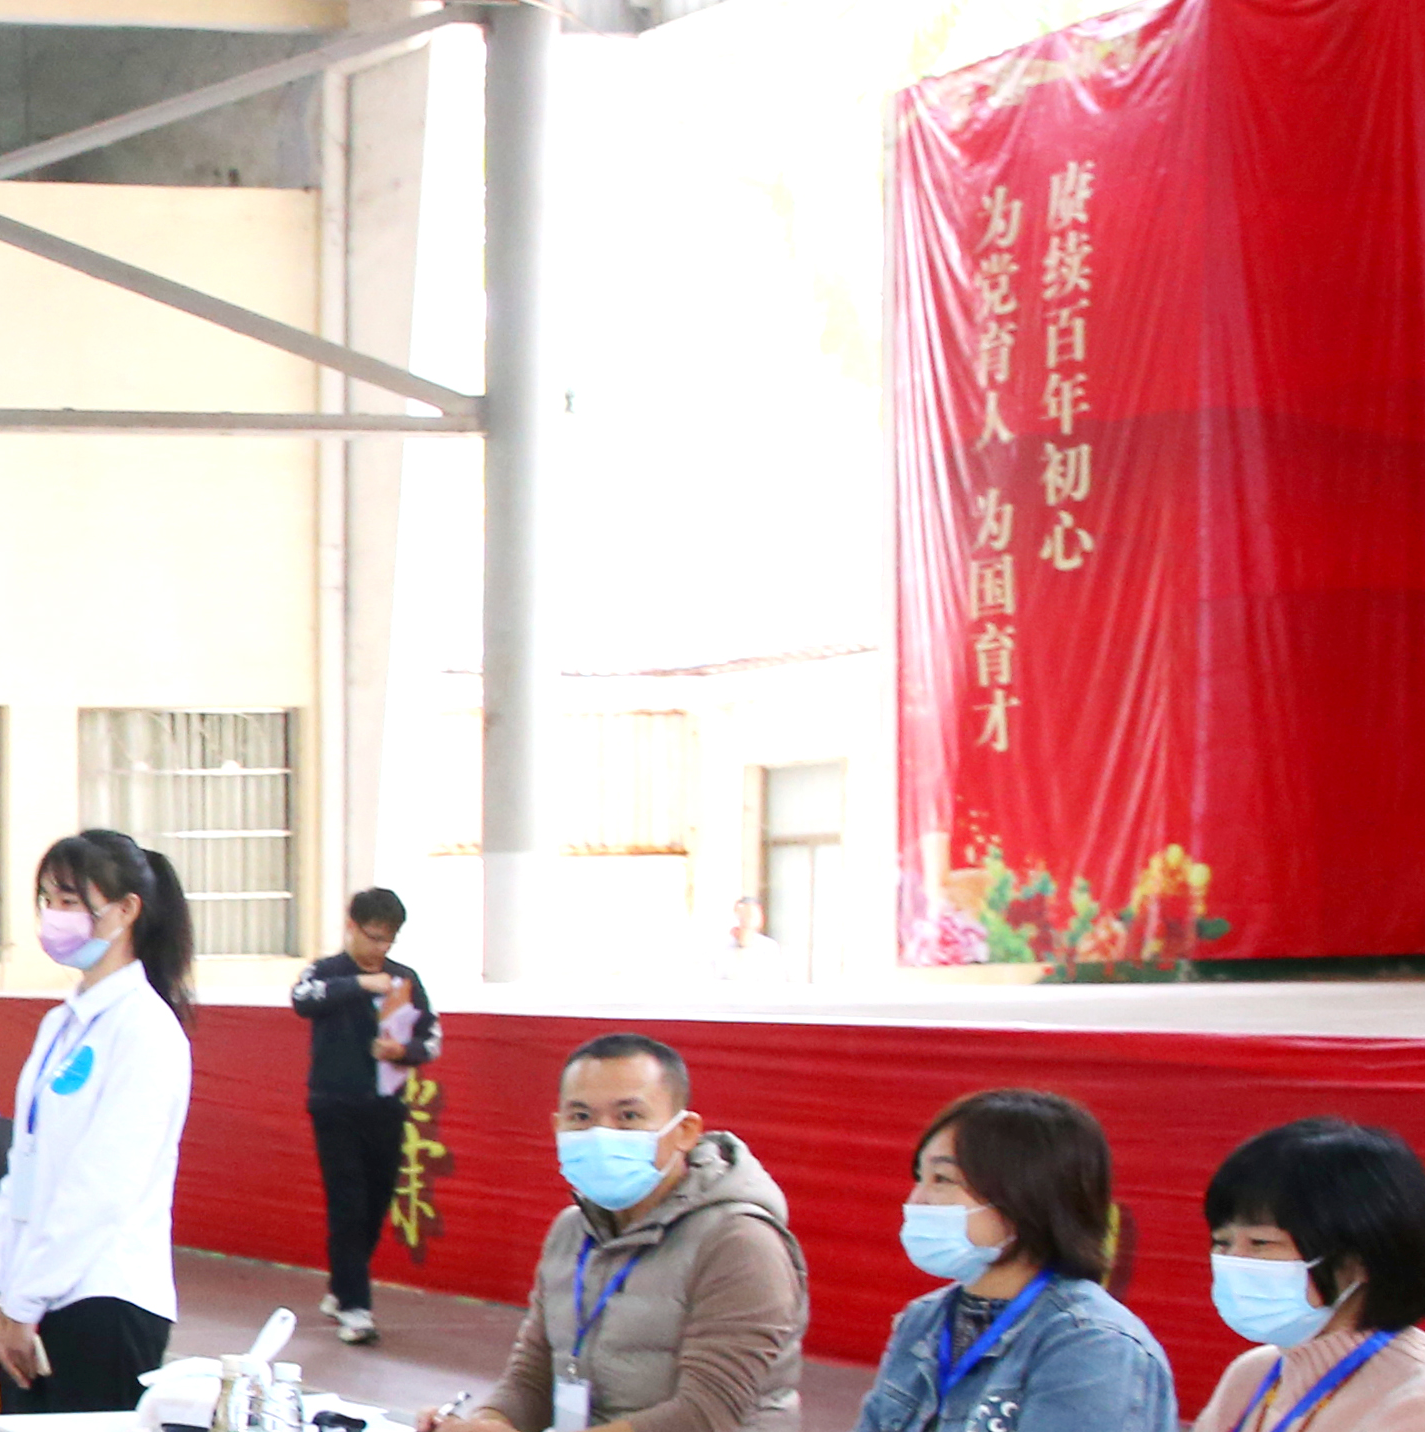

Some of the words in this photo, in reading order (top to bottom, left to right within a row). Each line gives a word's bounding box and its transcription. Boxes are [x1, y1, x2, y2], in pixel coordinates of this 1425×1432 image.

[971, 184, 1022, 454] 为党育人
[970, 488, 1020, 753] 为国育才
